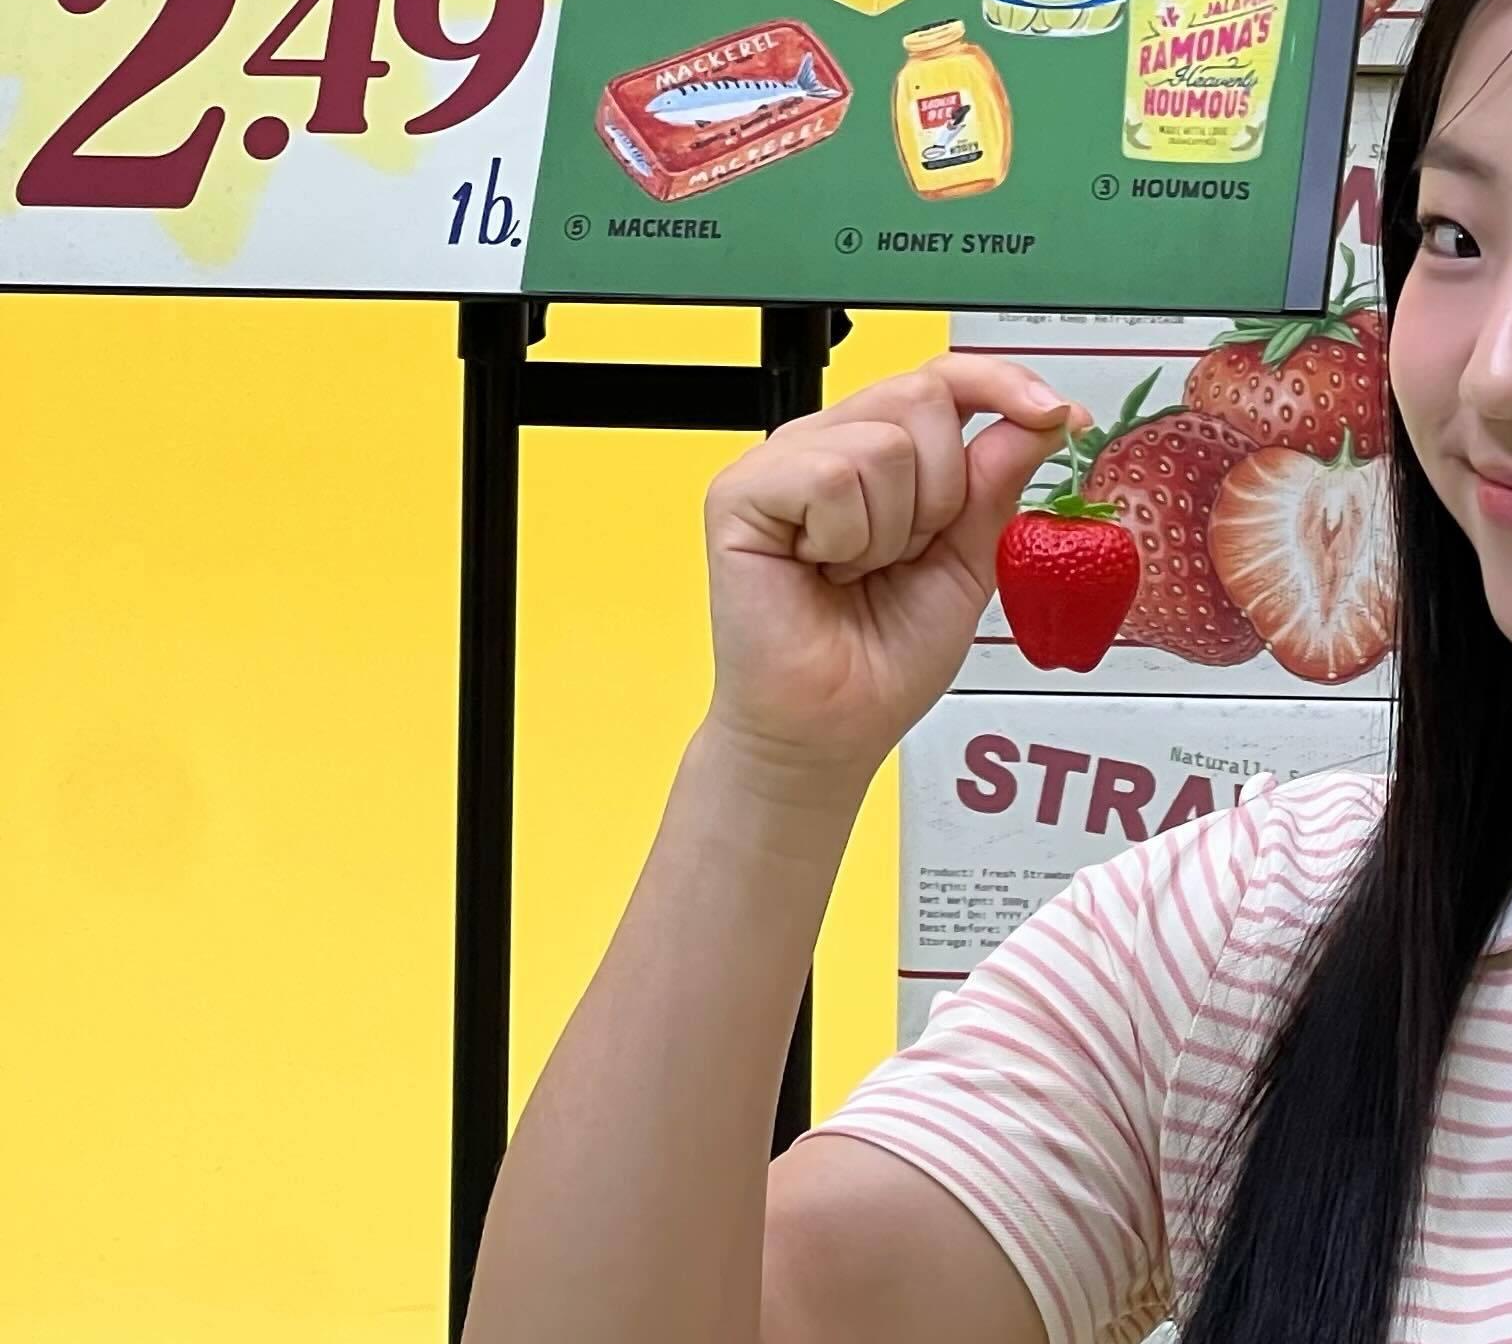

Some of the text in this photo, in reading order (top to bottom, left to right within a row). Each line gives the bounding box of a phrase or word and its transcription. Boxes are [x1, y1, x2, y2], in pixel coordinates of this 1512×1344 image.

[1139, 11, 1272, 77] RAMONA'S
[655, 32, 779, 90] MACKEREL
[1167, 63, 1258, 93] Heavenly
[1143, 88, 1250, 119] HOUMOUS
[1131, 178, 1251, 200] HOUMOUS
[607, 218, 722, 240] MACKEREL
[877, 231, 953, 253] HONEY
[961, 233, 1036, 254] SYRUP
[1170, 746, 1276, 776] Naturall
[955, 733, 1247, 843] STRA
